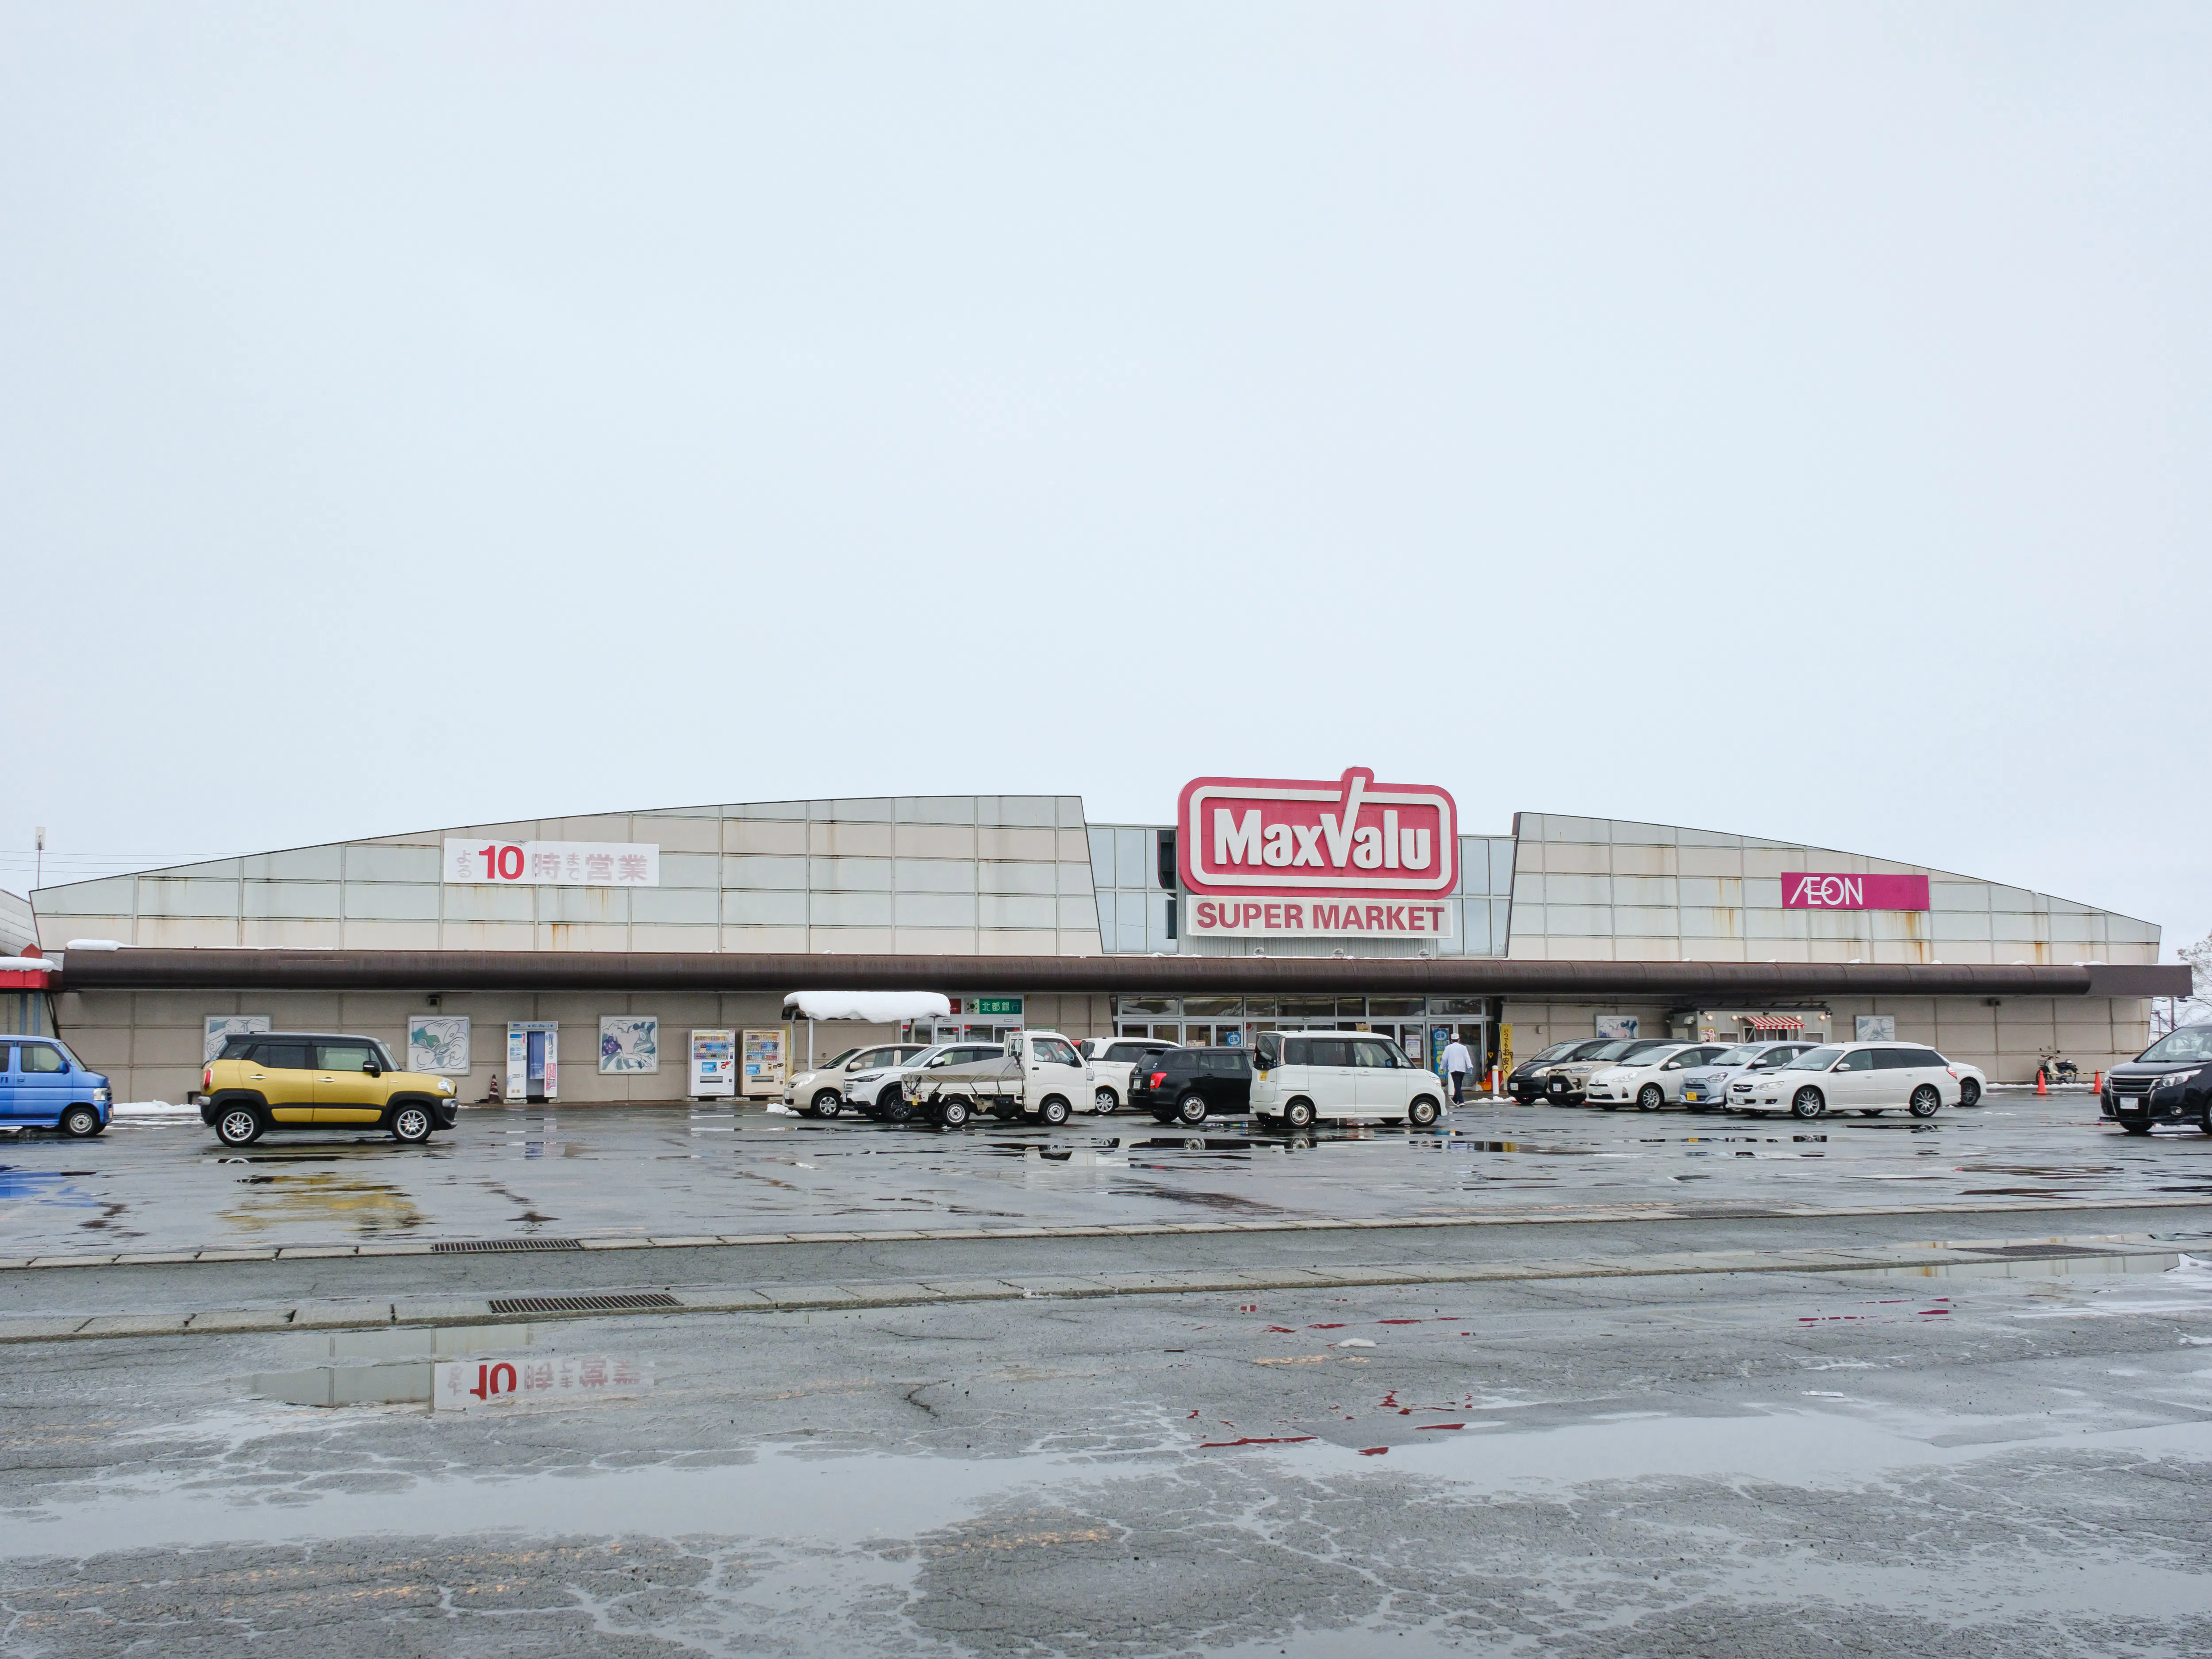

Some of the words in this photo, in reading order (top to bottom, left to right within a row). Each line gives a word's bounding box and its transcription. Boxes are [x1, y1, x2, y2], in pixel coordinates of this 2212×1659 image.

[1214, 776, 1431, 870] MaxValu
[1197, 902, 1304, 929] SUPER
[1313, 904, 1445, 931] MARKET
[982, 1002, 1019, 1011] 北都銀行
